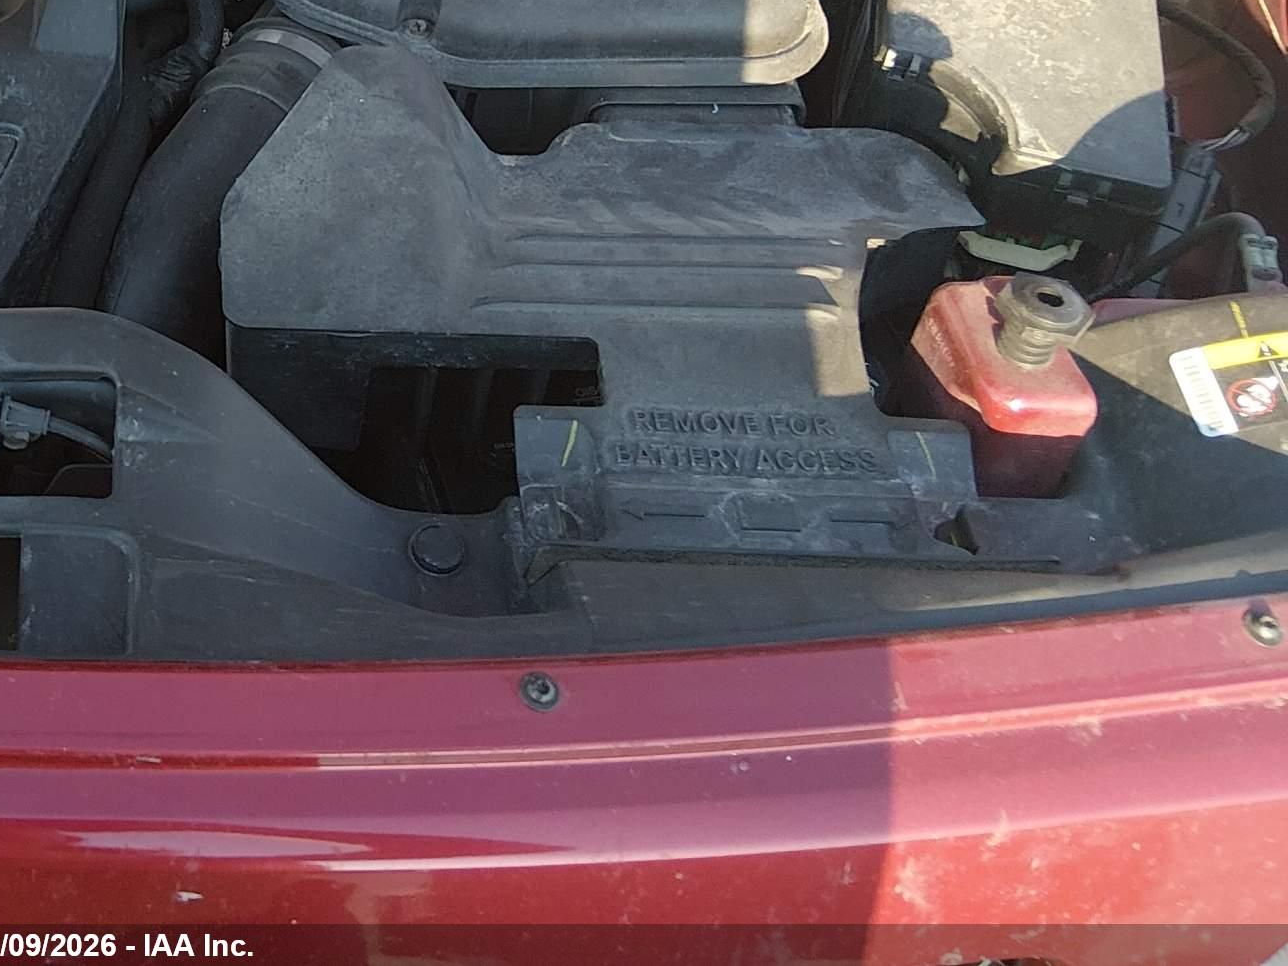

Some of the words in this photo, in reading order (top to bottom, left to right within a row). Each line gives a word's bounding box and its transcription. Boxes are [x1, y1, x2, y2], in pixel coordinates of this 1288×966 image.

[631, 408, 763, 436] REMOVE
[769, 411, 835, 437] FOR
[615, 443, 743, 470] BATTERY
[756, 448, 879, 475] ACCESS
